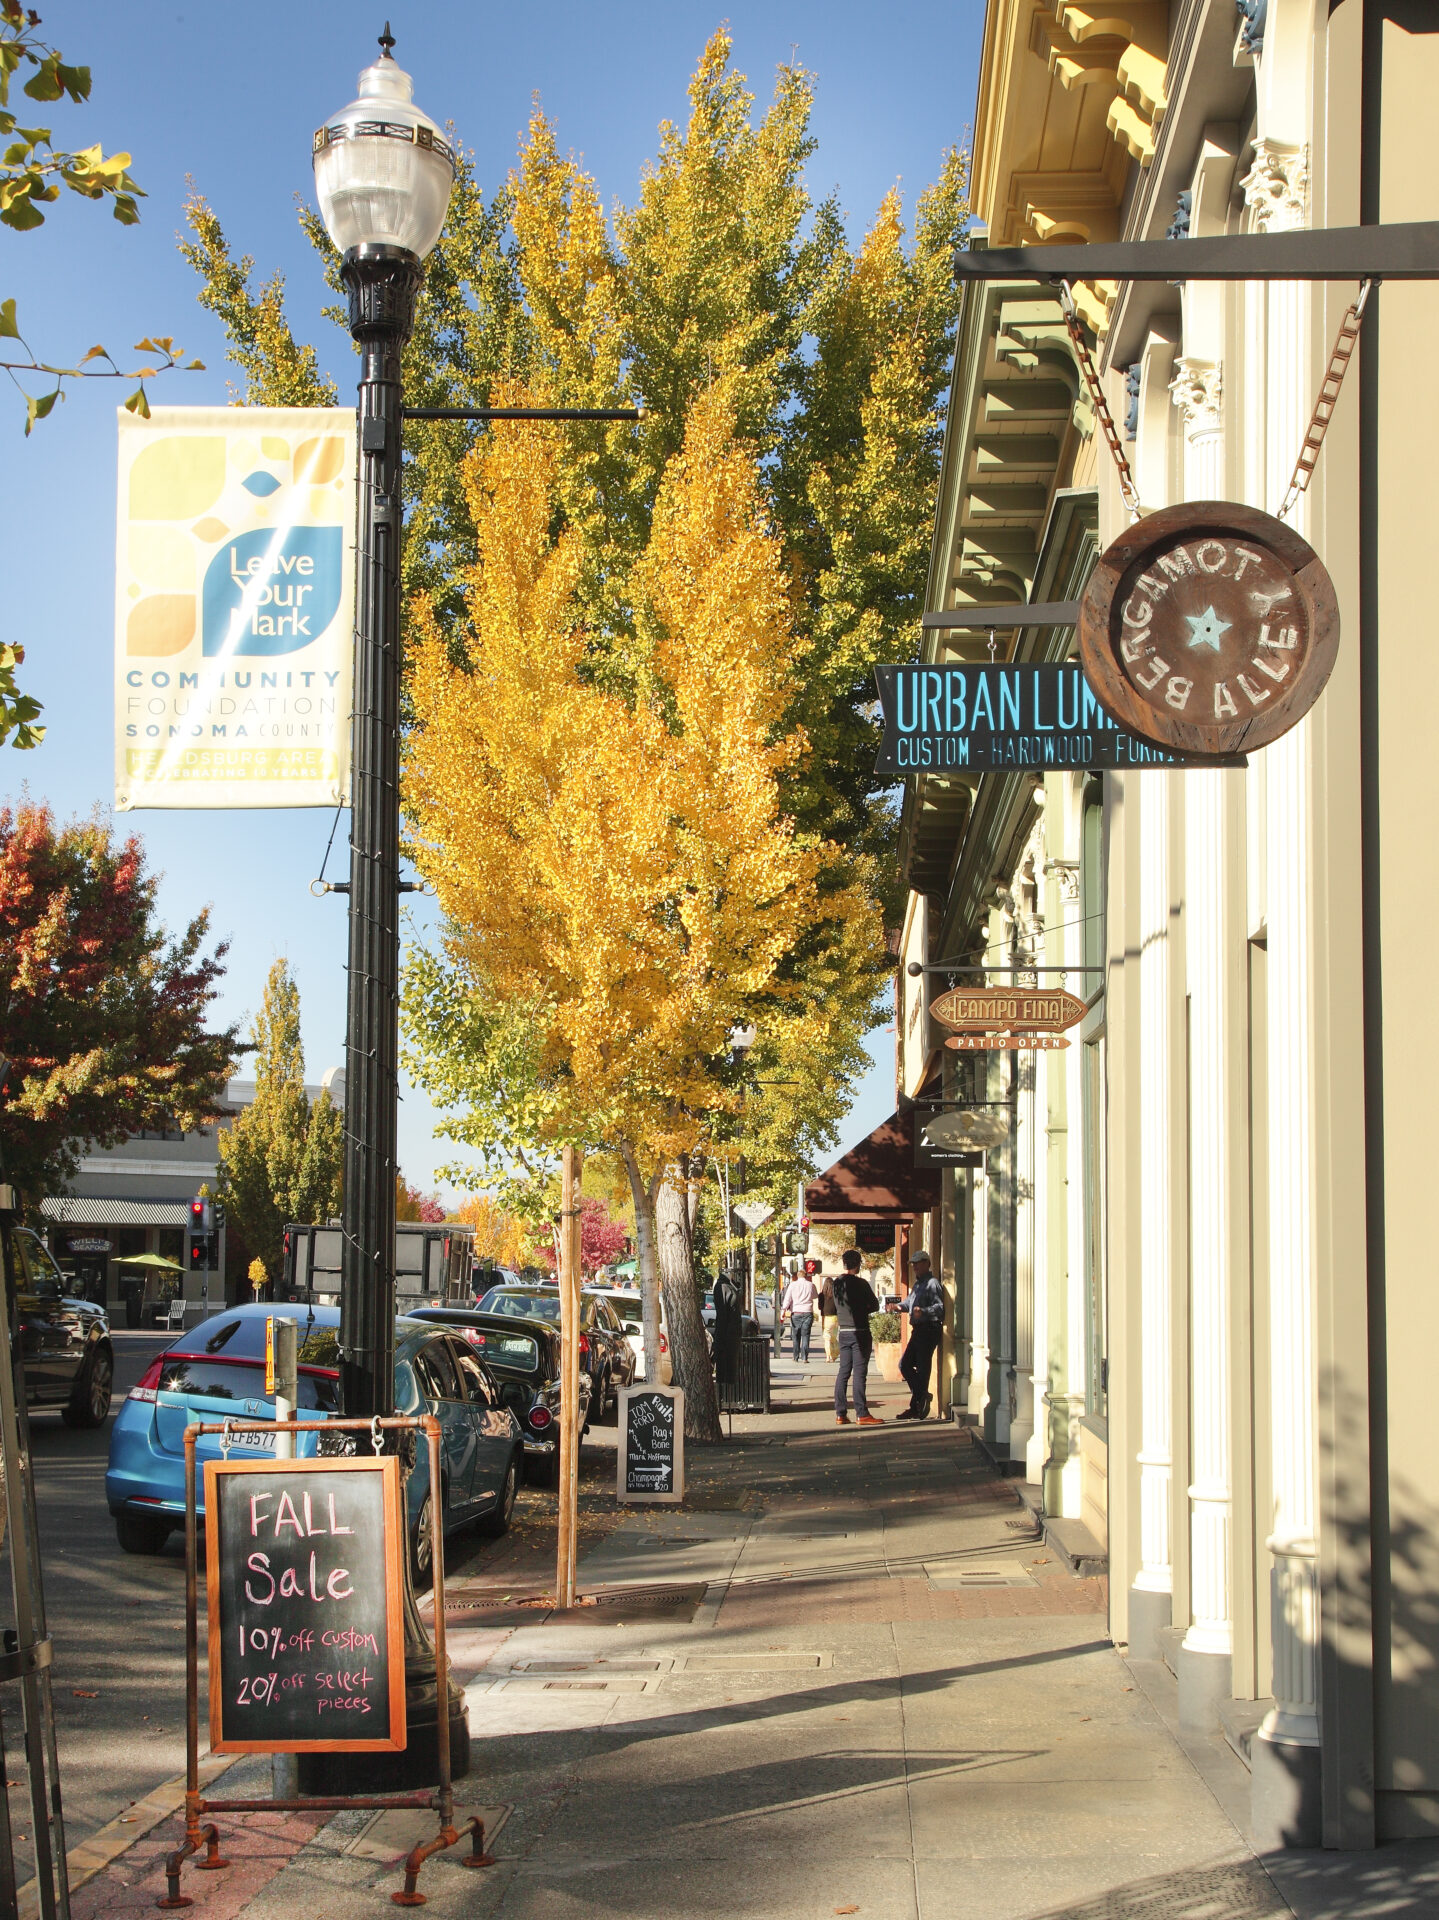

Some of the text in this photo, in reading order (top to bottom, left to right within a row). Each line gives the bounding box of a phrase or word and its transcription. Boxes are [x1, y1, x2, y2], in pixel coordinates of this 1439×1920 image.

[1214, 587, 1298, 718] ALLEY
[897, 669, 1119, 732] URBAN LUM
[126, 723, 335, 737] SONOMA COUNTY
[131, 751, 267, 766] HEDSBURG
[897, 737, 969, 766] CUSTOM
[992, 735, 1093, 765] HARDWOOD
[958, 999, 1060, 1019] CAMPO FINA
[958, 1038, 1060, 1048] PATIO OPEN
[629, 1401, 652, 1418] TOM
[651, 1395, 674, 1423] Rails
[632, 1413, 655, 1428] FORD
[652, 1425, 667, 1441] Rag
[651, 1439, 670, 1449] Bone
[654, 1481, 669, 1491] $20
[249, 1490, 355, 1537] FALL
[245, 1550, 355, 1605] Sale
[239, 1624, 287, 1660] 10%
[289, 1628, 315, 1652] off
[237, 1672, 281, 1707] 20%
[281, 1673, 307, 1689] off
[317, 1696, 372, 1715] pieces
